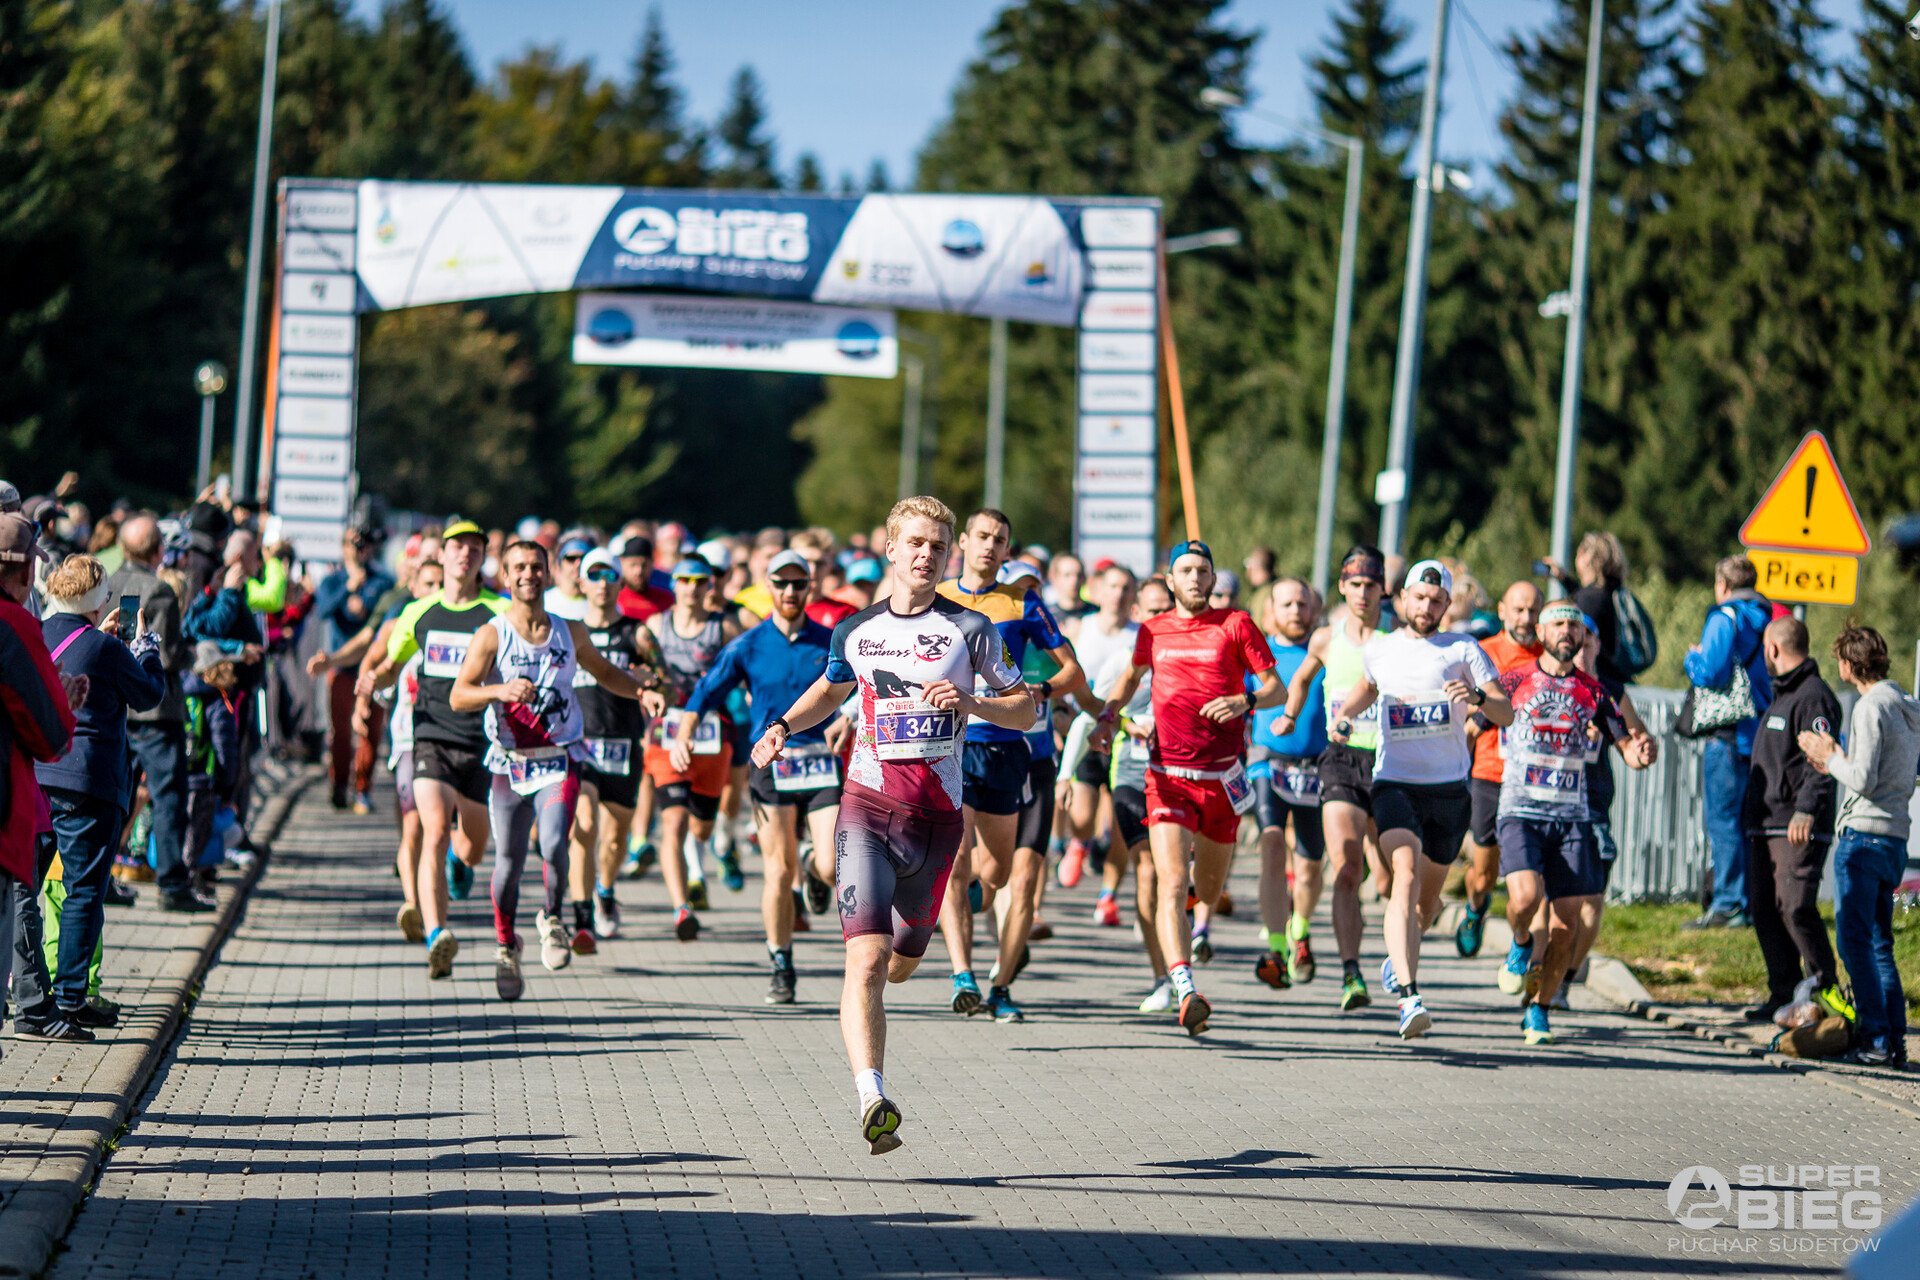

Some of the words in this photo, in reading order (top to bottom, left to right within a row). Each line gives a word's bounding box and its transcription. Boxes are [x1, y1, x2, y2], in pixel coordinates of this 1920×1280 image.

[675, 223, 810, 263] BIEG
[1767, 560, 1837, 591] Piesi
[857, 646, 912, 658] Runners
[858, 638, 886, 650] Mad
[1410, 705, 1444, 724] 474
[905, 716, 946, 738] 347
[1546, 770, 1575, 789] 470
